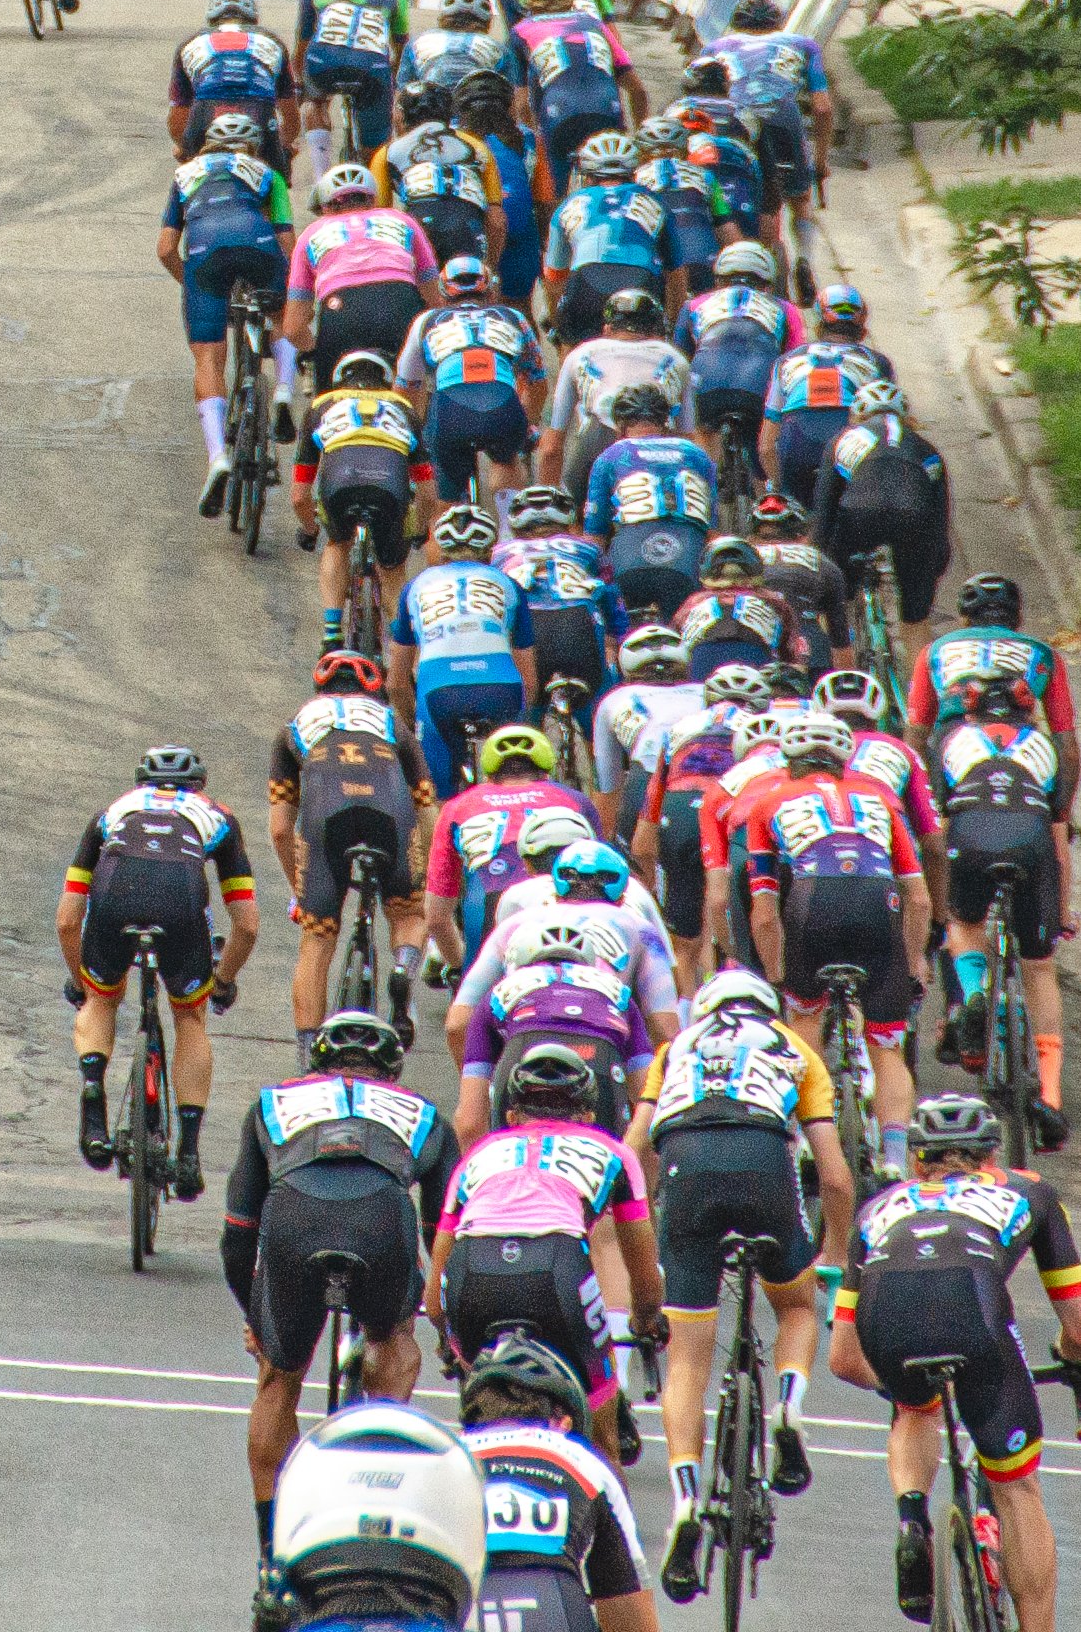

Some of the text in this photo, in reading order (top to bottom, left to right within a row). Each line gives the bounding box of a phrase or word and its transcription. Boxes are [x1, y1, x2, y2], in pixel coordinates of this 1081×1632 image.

[322, 4, 353, 44] 246
[359, 9, 387, 52] 246
[617, 476, 654, 523] 202
[685, 472, 713, 521] 202
[420, 583, 456, 626] 239
[469, 578, 504, 620] 239
